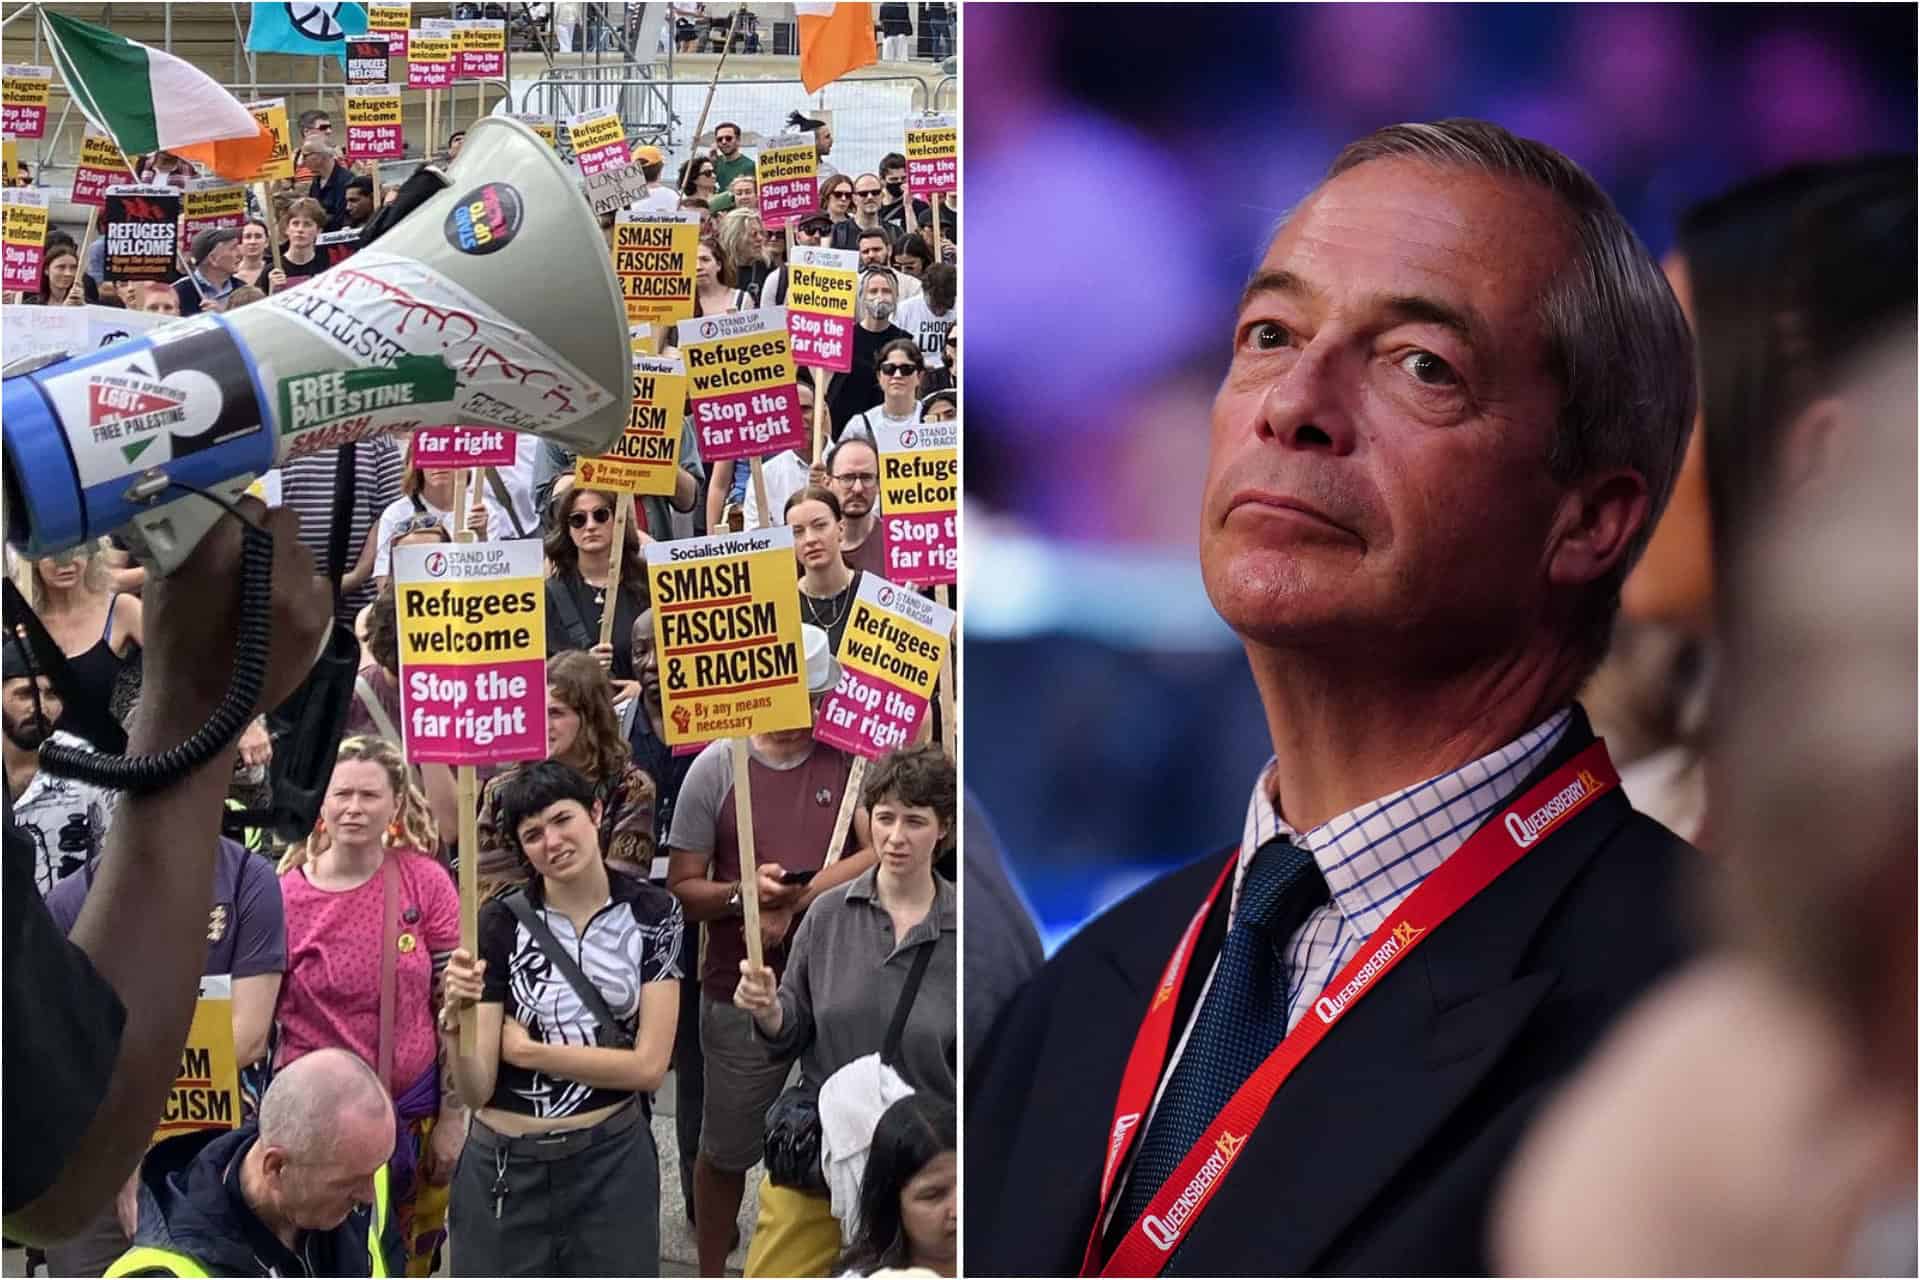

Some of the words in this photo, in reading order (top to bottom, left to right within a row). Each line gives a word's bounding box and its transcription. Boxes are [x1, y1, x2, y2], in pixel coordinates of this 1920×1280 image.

[3, 80, 47, 92] efugees
[3, 91, 43, 101] elcome
[349, 100, 398, 111] Refugees
[350, 113, 396, 122] welcome
[350, 128, 374, 140] Stop
[377, 127, 395, 138] the
[907, 131, 956, 143] Refugees
[350, 141, 367, 151] far
[369, 139, 396, 152] right
[908, 144, 955, 156] welcome
[760, 150, 813, 167] Refugees
[909, 162, 934, 174] Stop
[937, 160, 955, 171] the
[78, 169, 105, 184] Stop
[760, 164, 811, 178] welcome
[910, 174, 927, 185] far
[929, 172, 955, 186] right
[76, 183, 94, 195] far
[762, 184, 787, 198] Stop
[791, 181, 811, 193] the
[470, 201, 488, 223] TO
[763, 198, 780, 210] far
[781, 195, 811, 210] right
[107, 223, 175, 239] REFUGEES
[456, 204, 477, 250] STAND
[474, 223, 493, 245] UP
[618, 228, 672, 246] SMASH
[107, 240, 173, 256] WELCOME
[616, 252, 683, 271] FASCISM
[632, 277, 692, 295] RACISM
[793, 270, 852, 292] Refugees
[792, 290, 848, 310] welcome
[719, 317, 745, 328] STAND
[748, 314, 759, 325] UP
[733, 322, 765, 335] RACISM
[791, 315, 820, 336] Stop
[824, 318, 844, 336] the
[688, 340, 786, 368] Refugees
[790, 335, 810, 352] far
[812, 338, 842, 358] right
[641, 363, 673, 373] Worker
[694, 364, 785, 390] welcome
[287, 372, 345, 405] FREE
[291, 382, 415, 428] PALESTINE
[698, 402, 747, 427] Stop
[752, 394, 788, 414] the
[92, 423, 122, 443] FREE
[124, 407, 186, 434] PALESTINE
[702, 427, 736, 446] far
[739, 416, 791, 443] right
[919, 428, 947, 437] STAND
[419, 431, 449, 451] far
[455, 427, 504, 455] right
[920, 439, 931, 448] TO
[886, 457, 957, 480] Refuge
[888, 483, 957, 505] welco
[889, 519, 939, 544] Stop
[450, 552, 484, 564] STAND
[487, 550, 504, 562] UP
[890, 546, 922, 569] far
[928, 544, 957, 570] rig
[450, 565, 462, 577] TO
[464, 562, 510, 577] RACISM
[657, 560, 751, 604] SMASH
[406, 589, 536, 623] Refugees
[895, 603, 905, 612] TO
[906, 606, 933, 625] RACISM
[897, 592, 921, 609] STAND
[921, 604, 933, 614] UP
[661, 601, 777, 647] FASCISM
[853, 606, 940, 662] Refugees
[409, 624, 530, 652] welcome
[667, 658, 688, 690] &
[695, 643, 798, 688] RACISM
[848, 638, 929, 686] welcome
[410, 671, 468, 710] Stop
[475, 670, 527, 699] the
[834, 671, 882, 711] Stop
[884, 691, 916, 723] the
[694, 702, 709, 717] By
[712, 702, 731, 716] any
[736, 696, 772, 711] means
[412, 707, 450, 738] far
[455, 705, 527, 745] right
[696, 714, 753, 731] necessary
[825, 698, 857, 729] far
[859, 715, 907, 750] right
[1504, 778, 1586, 848] QUEENSBERRY
[1315, 936, 1400, 1024] QUEENSBERRY
[163, 1089, 233, 1122] CISM
[1141, 1153, 1225, 1250] QUEENSBERRY
